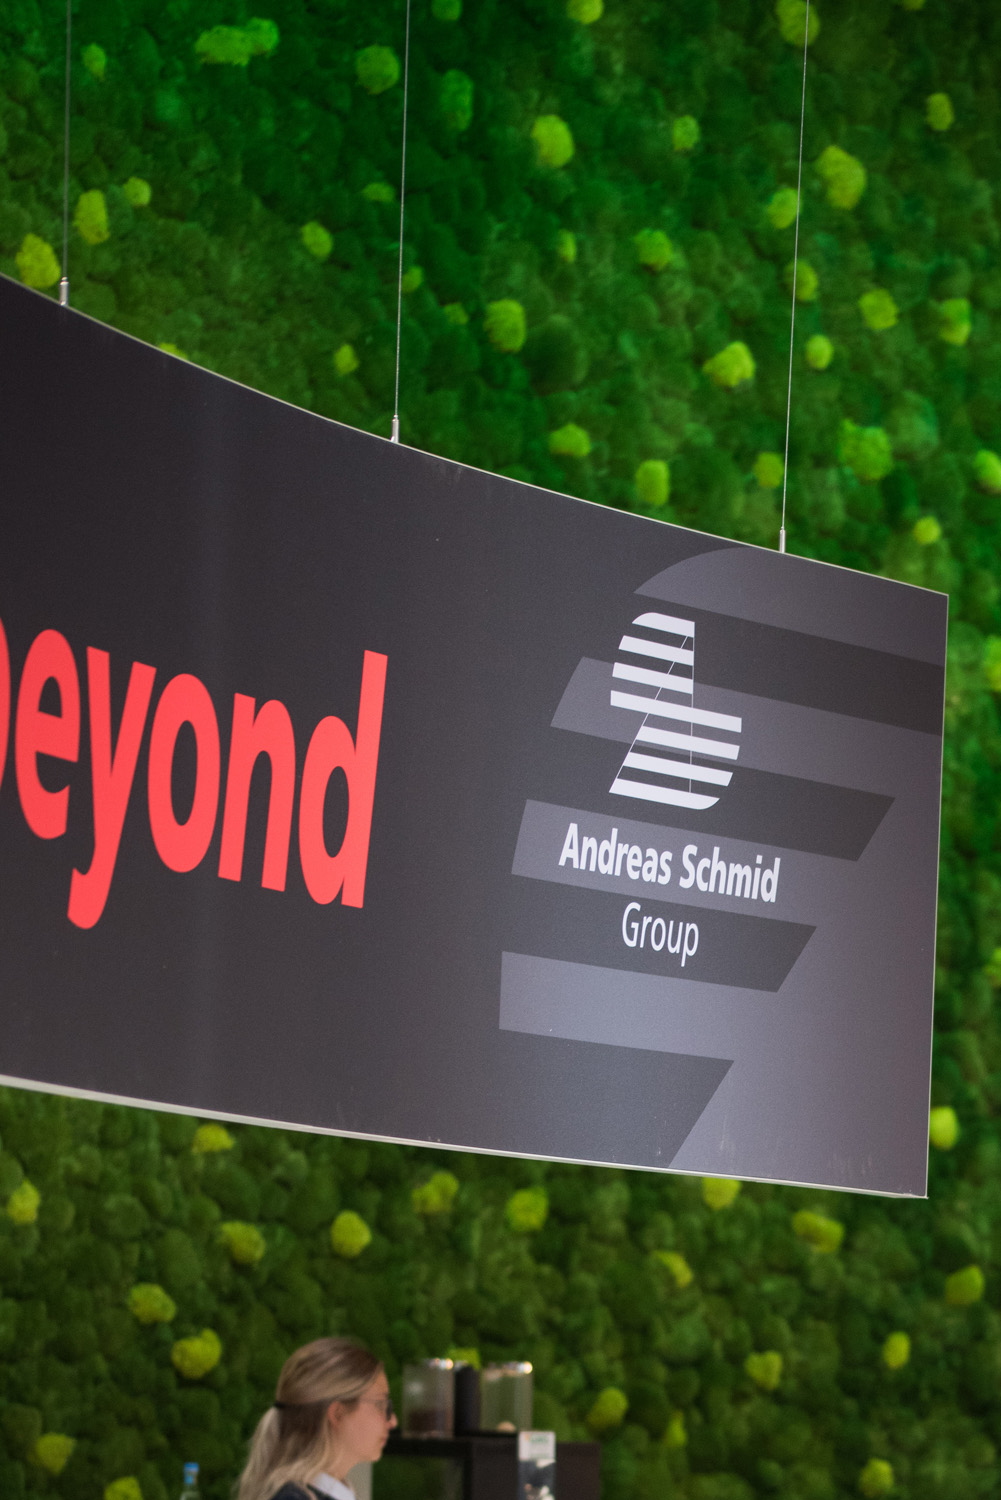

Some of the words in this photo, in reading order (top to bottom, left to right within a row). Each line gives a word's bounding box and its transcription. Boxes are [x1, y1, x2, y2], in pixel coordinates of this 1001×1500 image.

[0, 617, 388, 929] eyond
[558, 822, 673, 885] Andreas
[679, 844, 781, 902] Schmid
[622, 902, 699, 967] Group
